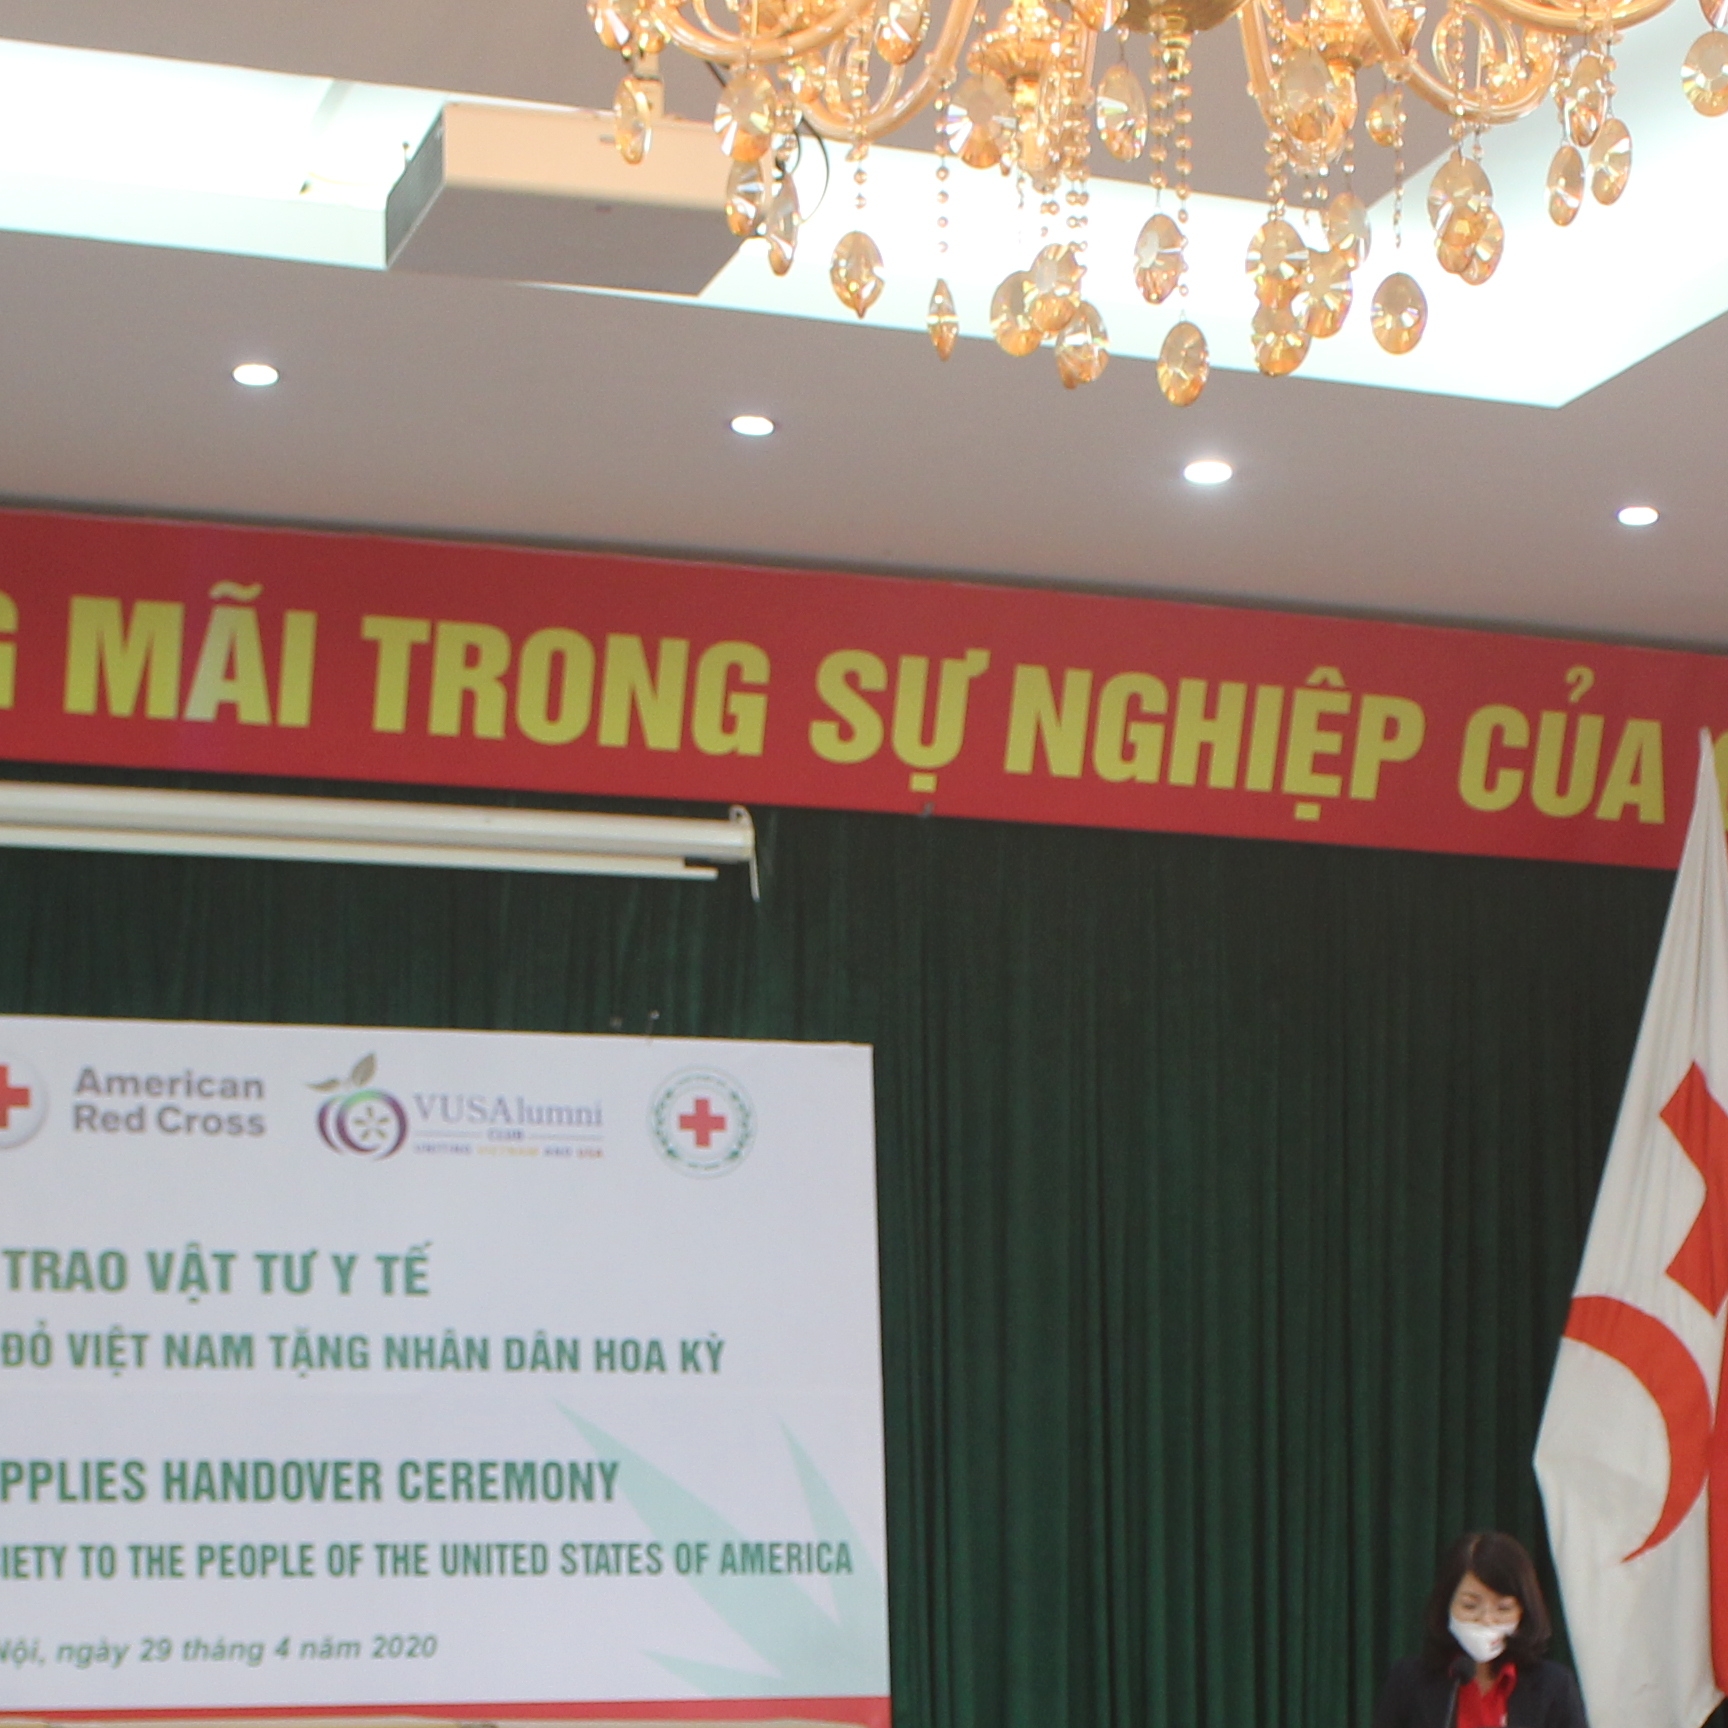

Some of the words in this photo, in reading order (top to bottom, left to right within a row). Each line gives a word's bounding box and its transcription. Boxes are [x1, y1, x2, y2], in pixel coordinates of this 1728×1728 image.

[63, 581, 318, 729] MÃI
[360, 614, 771, 757] TRONG
[808, 647, 991, 793] SỰ
[1002, 667, 1426, 822] NGHIỆP
[1457, 666, 1666, 826] CỦA
[74, 1065, 265, 1100] American
[73, 1102, 147, 1134] Red
[155, 1102, 266, 1137] Cross
[412, 1091, 603, 1126] VUSAlumni
[1, 1248, 128, 1293] TRAO
[146, 1241, 237, 1303] VẬT
[254, 1249, 318, 1295] TƯ
[329, 1253, 359, 1295] Y
[375, 1240, 434, 1296] TẾ
[0, 1321, 53, 1368] ĐỎ
[67, 1325, 149, 1377] VIỆT
[163, 1334, 254, 1369] NAM
[268, 1331, 370, 1378] TẶNG
[383, 1329, 489, 1371] NHÂN
[503, 1330, 579, 1372] DÂN
[594, 1337, 667, 1373] HOA
[680, 1332, 725, 1374] KỲ
[162, 1459, 382, 1502] HANDOVER
[397, 1459, 621, 1502] CEREMONY
[78, 1543, 117, 1579] TO
[128, 1543, 184, 1578] THE
[196, 1543, 315, 1578] PEOPLE
[326, 1543, 363, 1578] OF
[374, 1543, 429, 1577] THE
[440, 1542, 549, 1577] UNITED
[559, 1541, 664, 1576] STATES
[674, 1541, 709, 1576] OF
[719, 1541, 854, 1576] AMERICA
[55, 1639, 130, 1670] ngày
[139, 1637, 173, 1663] 29
[182, 1636, 264, 1667] tháng
[273, 1635, 292, 1660] 4
[298, 1636, 362, 1660] năm
[371, 1634, 438, 1660] 2020
